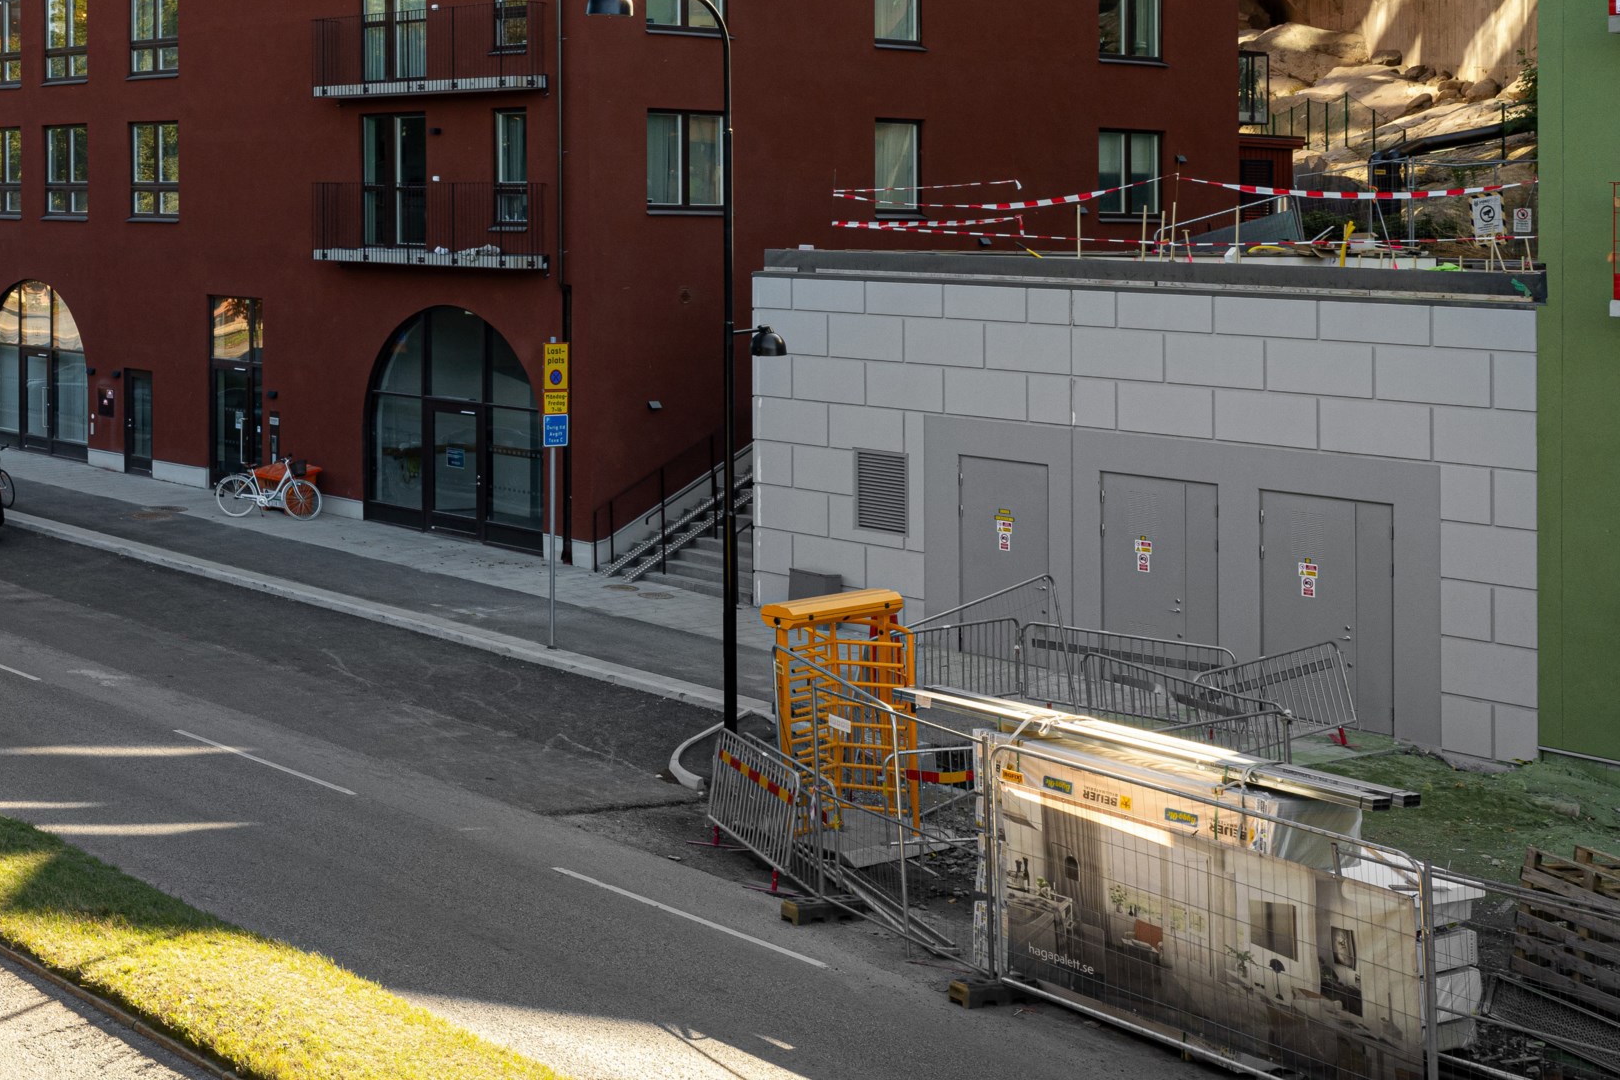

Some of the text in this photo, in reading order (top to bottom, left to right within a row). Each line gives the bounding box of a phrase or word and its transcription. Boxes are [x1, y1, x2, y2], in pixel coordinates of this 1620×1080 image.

[547, 357, 565, 365] plats
[1082, 789, 1118, 807] BEIJER
[1028, 941, 1095, 975] hagapalett.se
